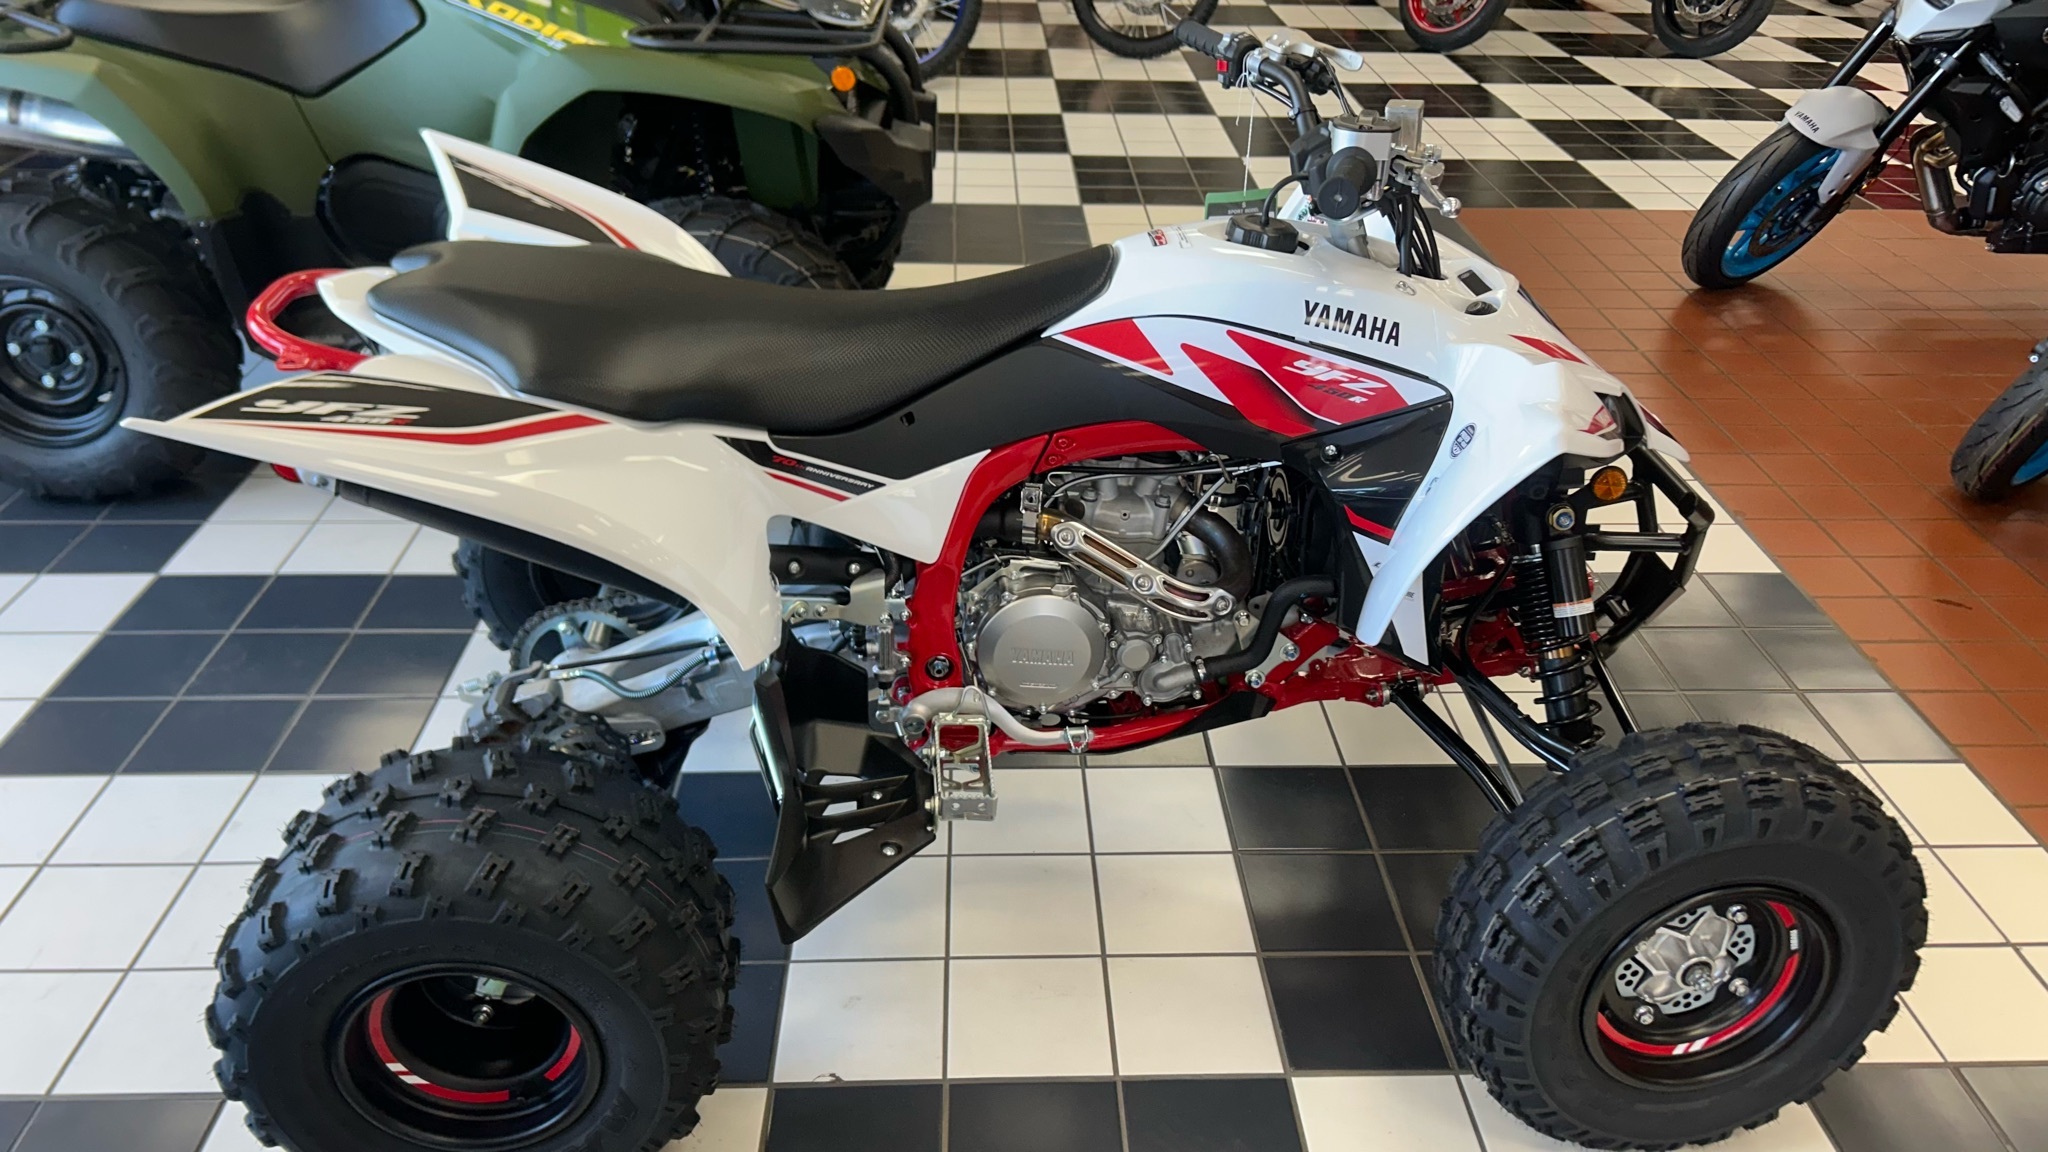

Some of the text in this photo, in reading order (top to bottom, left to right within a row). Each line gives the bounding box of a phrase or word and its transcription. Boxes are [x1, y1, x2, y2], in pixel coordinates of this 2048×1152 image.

[464, 0, 610, 46] ODI
[1794, 111, 1820, 134] YAMAHA
[1241, 201, 1247, 209] S
[1304, 299, 1400, 347] YAMAHA
[805, 465, 876, 490] ANNIVERSARY
